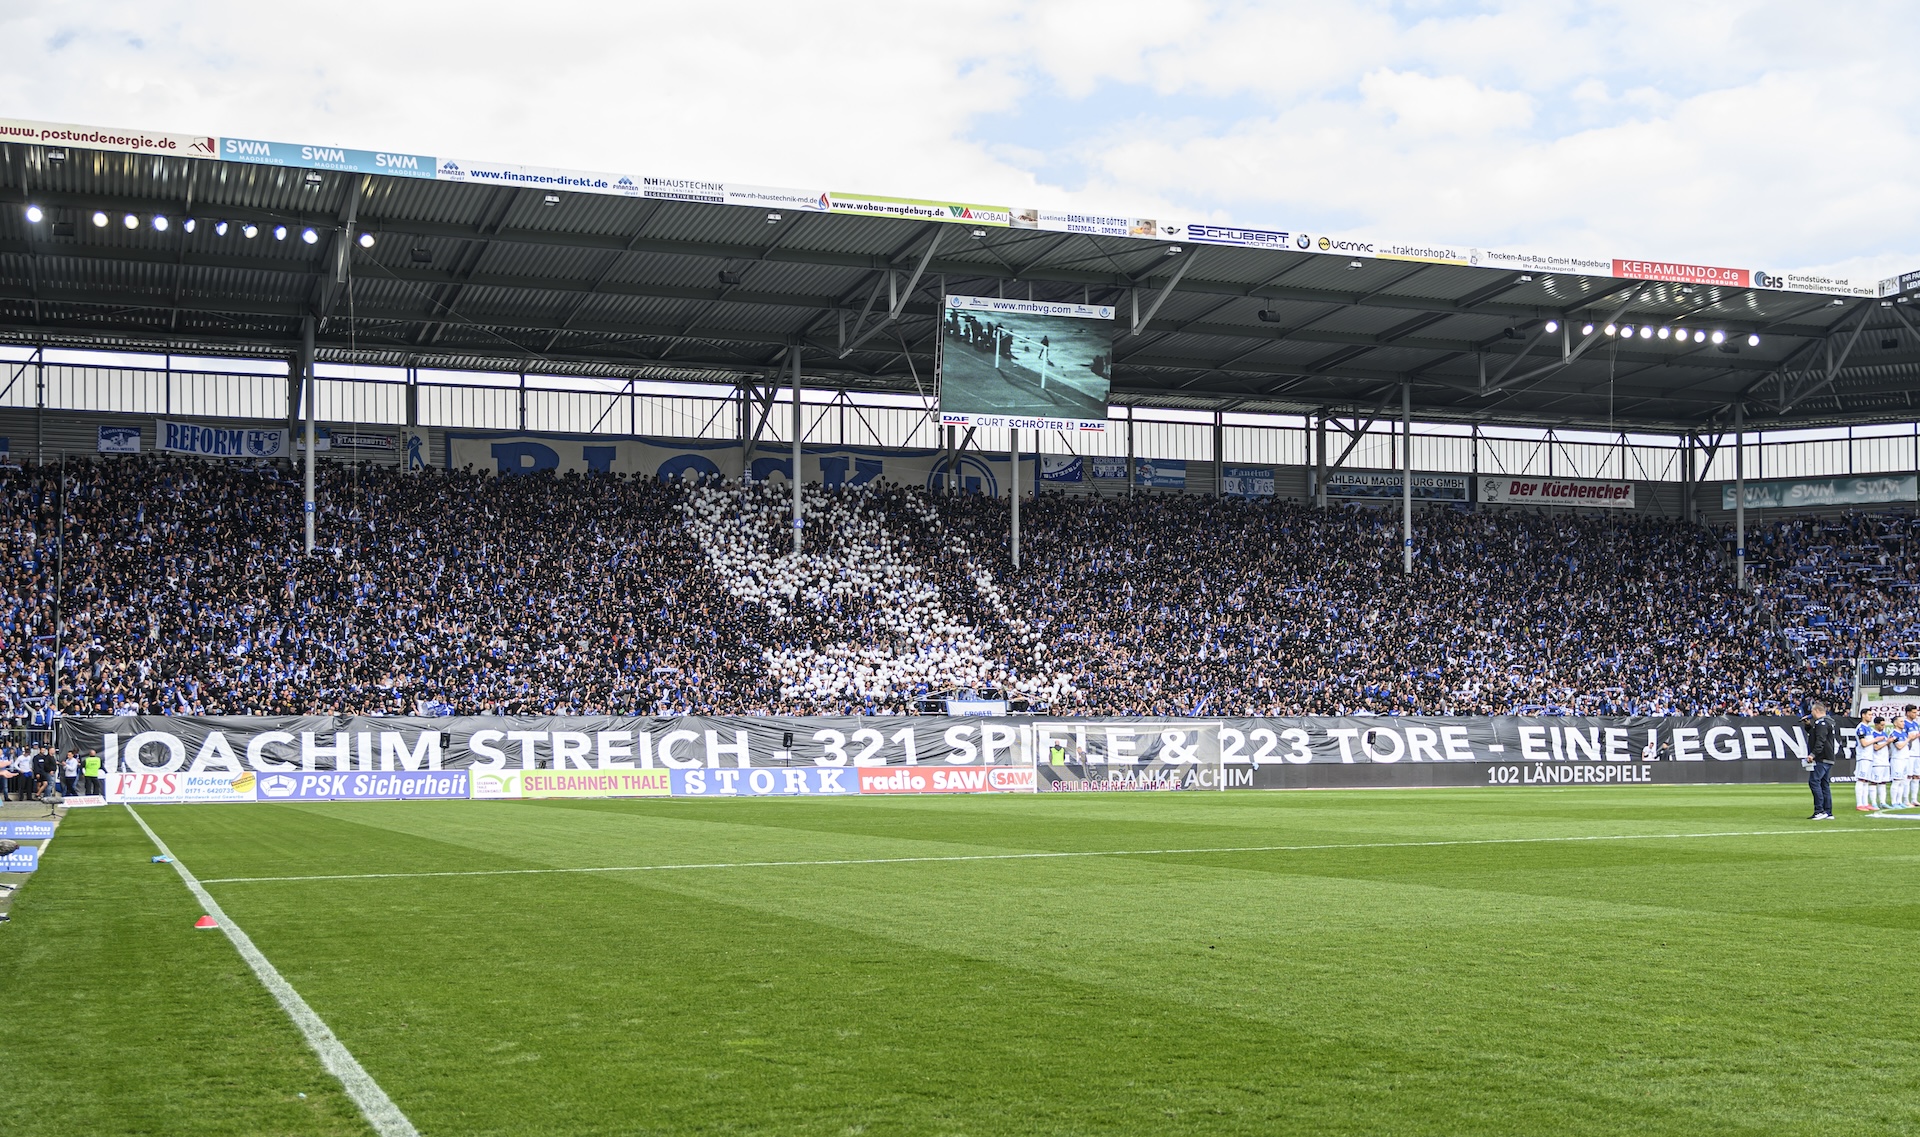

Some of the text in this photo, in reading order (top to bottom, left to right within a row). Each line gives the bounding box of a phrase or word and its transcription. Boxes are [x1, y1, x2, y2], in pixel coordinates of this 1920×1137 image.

[0, 126, 177, 150] www.postundenergie.de
[226, 140, 270, 156] SWM
[301, 146, 345, 163] SWM
[239, 155, 284, 164] MAGDEBURG
[314, 162, 358, 171] MAGDEBURG
[375, 153, 418, 170] SWM
[388, 168, 430, 177] MAGDEBURG
[470, 170, 608, 189] www.finanzen-direkt.de
[730, 191, 818, 204] www.nh-haustechnik-md.de
[832, 201, 944, 217] www.wobau-magdeburg.de
[973, 211, 1007, 222] WOBAU
[1067, 214, 1085, 223] BADEN
[1106, 217, 1127, 226] GÖTTER
[1067, 224, 1097, 233] EINMAL
[1188, 224, 1289, 243] SCHUBERT
[1488, 251, 1610, 269] Trocken-Aus-Bau GmbH Magdeburg
[1622, 261, 1738, 280] KERAMUNDO.de
[1763, 276, 1783, 288] GIS
[1788, 275, 1833, 284] Grundstücks-
[1886, 276, 1898, 290] 2K
[1788, 282, 1851, 294] Immobilienservice
[993, 301, 1071, 314] www.mnbvg.com
[977, 418, 1004, 427] CURT
[1009, 418, 1063, 430] SCHRÖTER
[165, 423, 243, 455] REFORM
[1228, 468, 1270, 477] Fanclub
[1224, 480, 1274, 492] 19 65
[1328, 476, 1368, 485] AHLBAU
[1436, 478, 1464, 488] GMBH
[1856, 480, 1900, 495] SWM
[1510, 481, 1630, 499] Der Küchenchef
[1726, 486, 1770, 501] SWM
[1792, 484, 1835, 498] SWM
[469, 730, 749, 770] STREICH
[812, 727, 918, 766] 321
[943, 724, 1139, 766] SPIELE
[1159, 728, 1203, 764] &
[1217, 728, 1313, 764] 223
[1327, 726, 1475, 764] TORE
[1518, 726, 1633, 762] EINE
[862, 770, 986, 790] radio SAW
[996, 772, 1032, 785] SAW
[1109, 769, 1182, 786] DANKE
[1184, 768, 1253, 787] ACHIM
[1488, 762, 1651, 783] 102 LÄNDERSPIELE
[115, 773, 177, 795] FBS
[300, 774, 466, 795] PSK Sicherheit
[524, 775, 668, 791] SEILBAHNEN THALE
[685, 769, 846, 794] STORK
